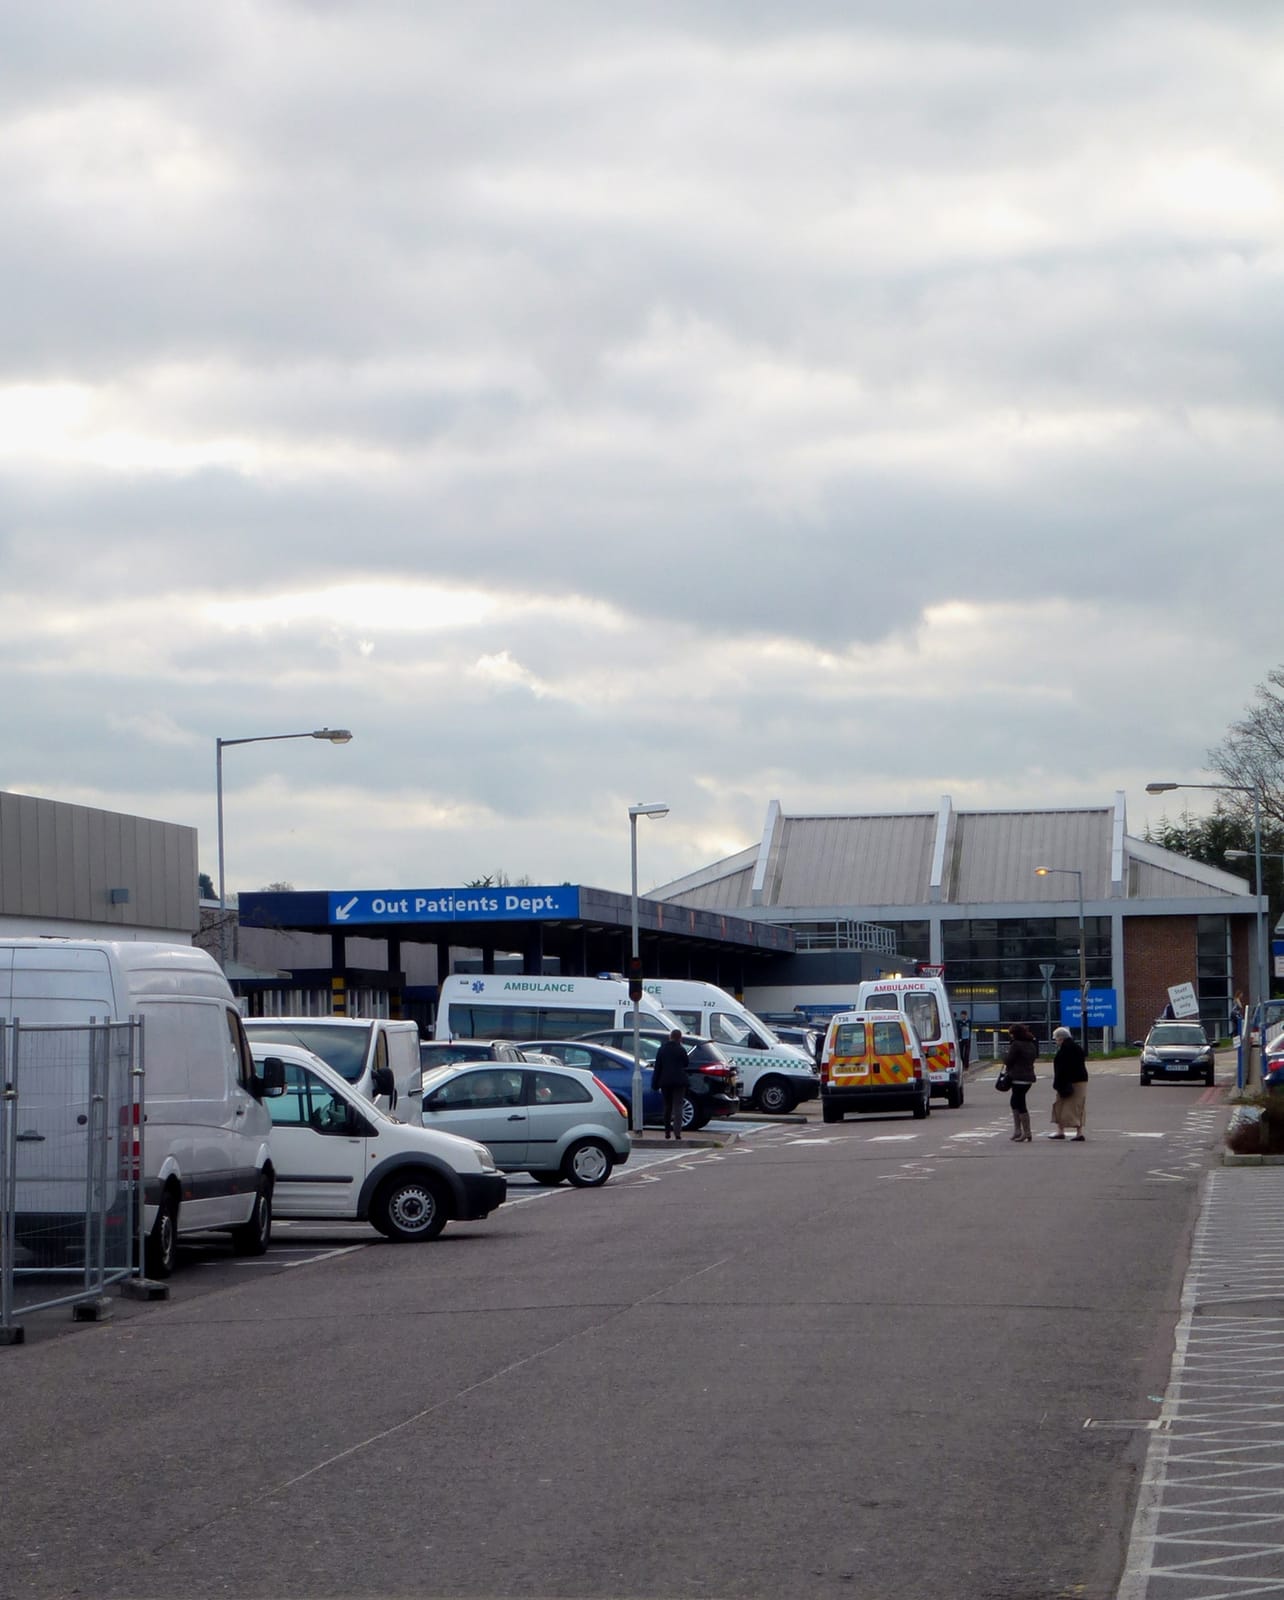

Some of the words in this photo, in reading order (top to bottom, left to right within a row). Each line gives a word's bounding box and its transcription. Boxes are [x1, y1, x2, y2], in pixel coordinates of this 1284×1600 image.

[371, 898, 408, 914] Out
[415, 896, 499, 913] Patients
[505, 894, 560, 913] Dept.
[503, 982, 575, 993] AMBULANCE
[874, 983, 926, 993] AMBULANCE
